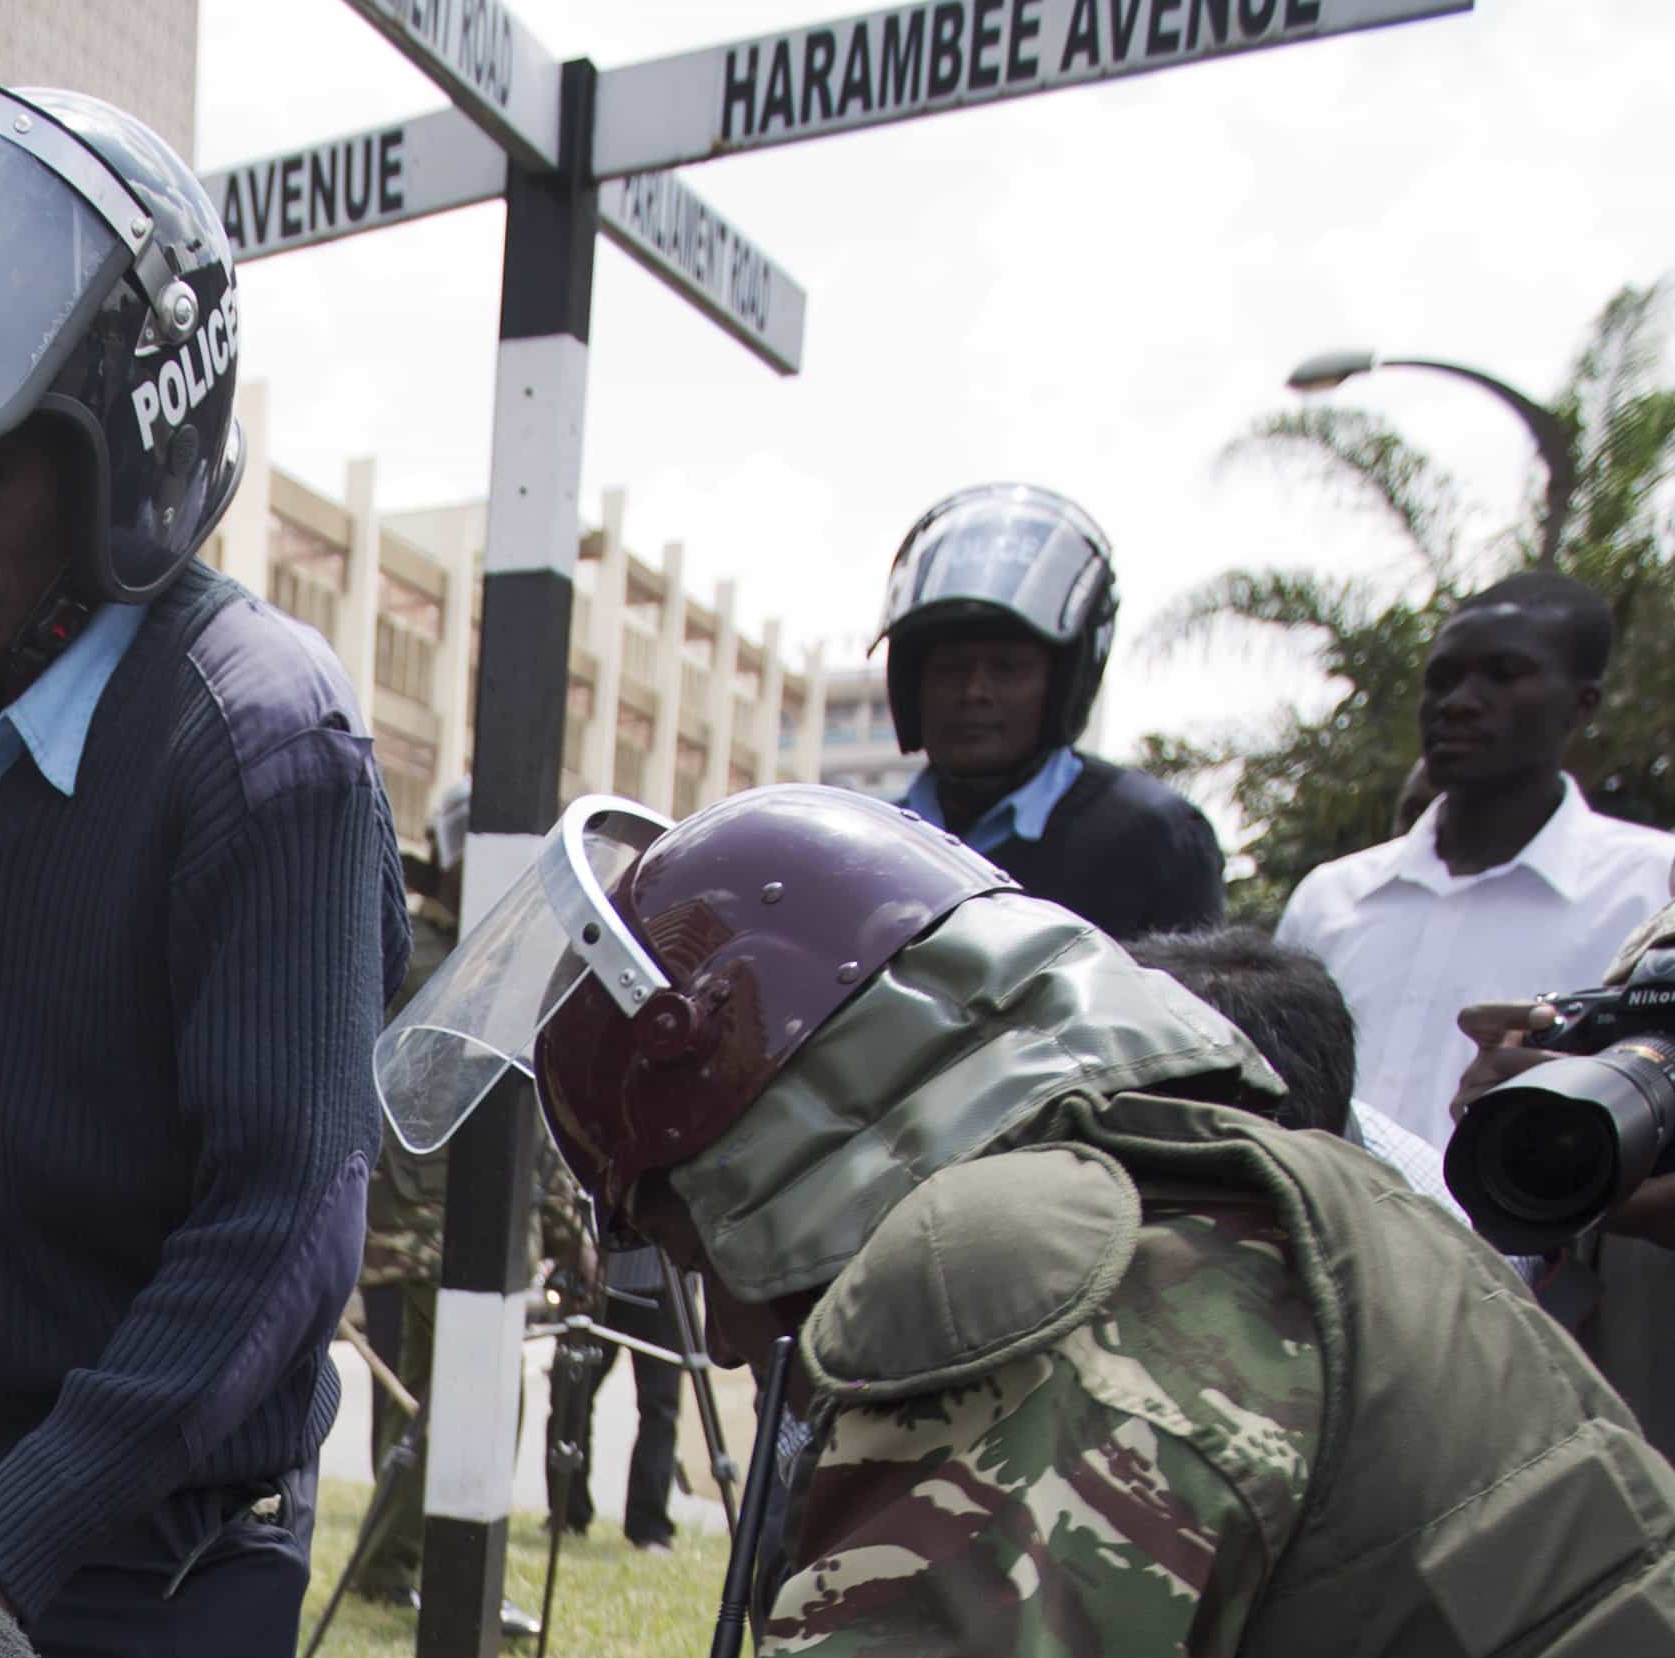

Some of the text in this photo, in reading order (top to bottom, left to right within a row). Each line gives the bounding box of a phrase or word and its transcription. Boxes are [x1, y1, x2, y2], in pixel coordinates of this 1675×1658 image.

[721, 0, 1042, 141] HARAMBEE
[223, 127, 404, 248] AVENUE
[131, 287, 239, 452] POLICE
